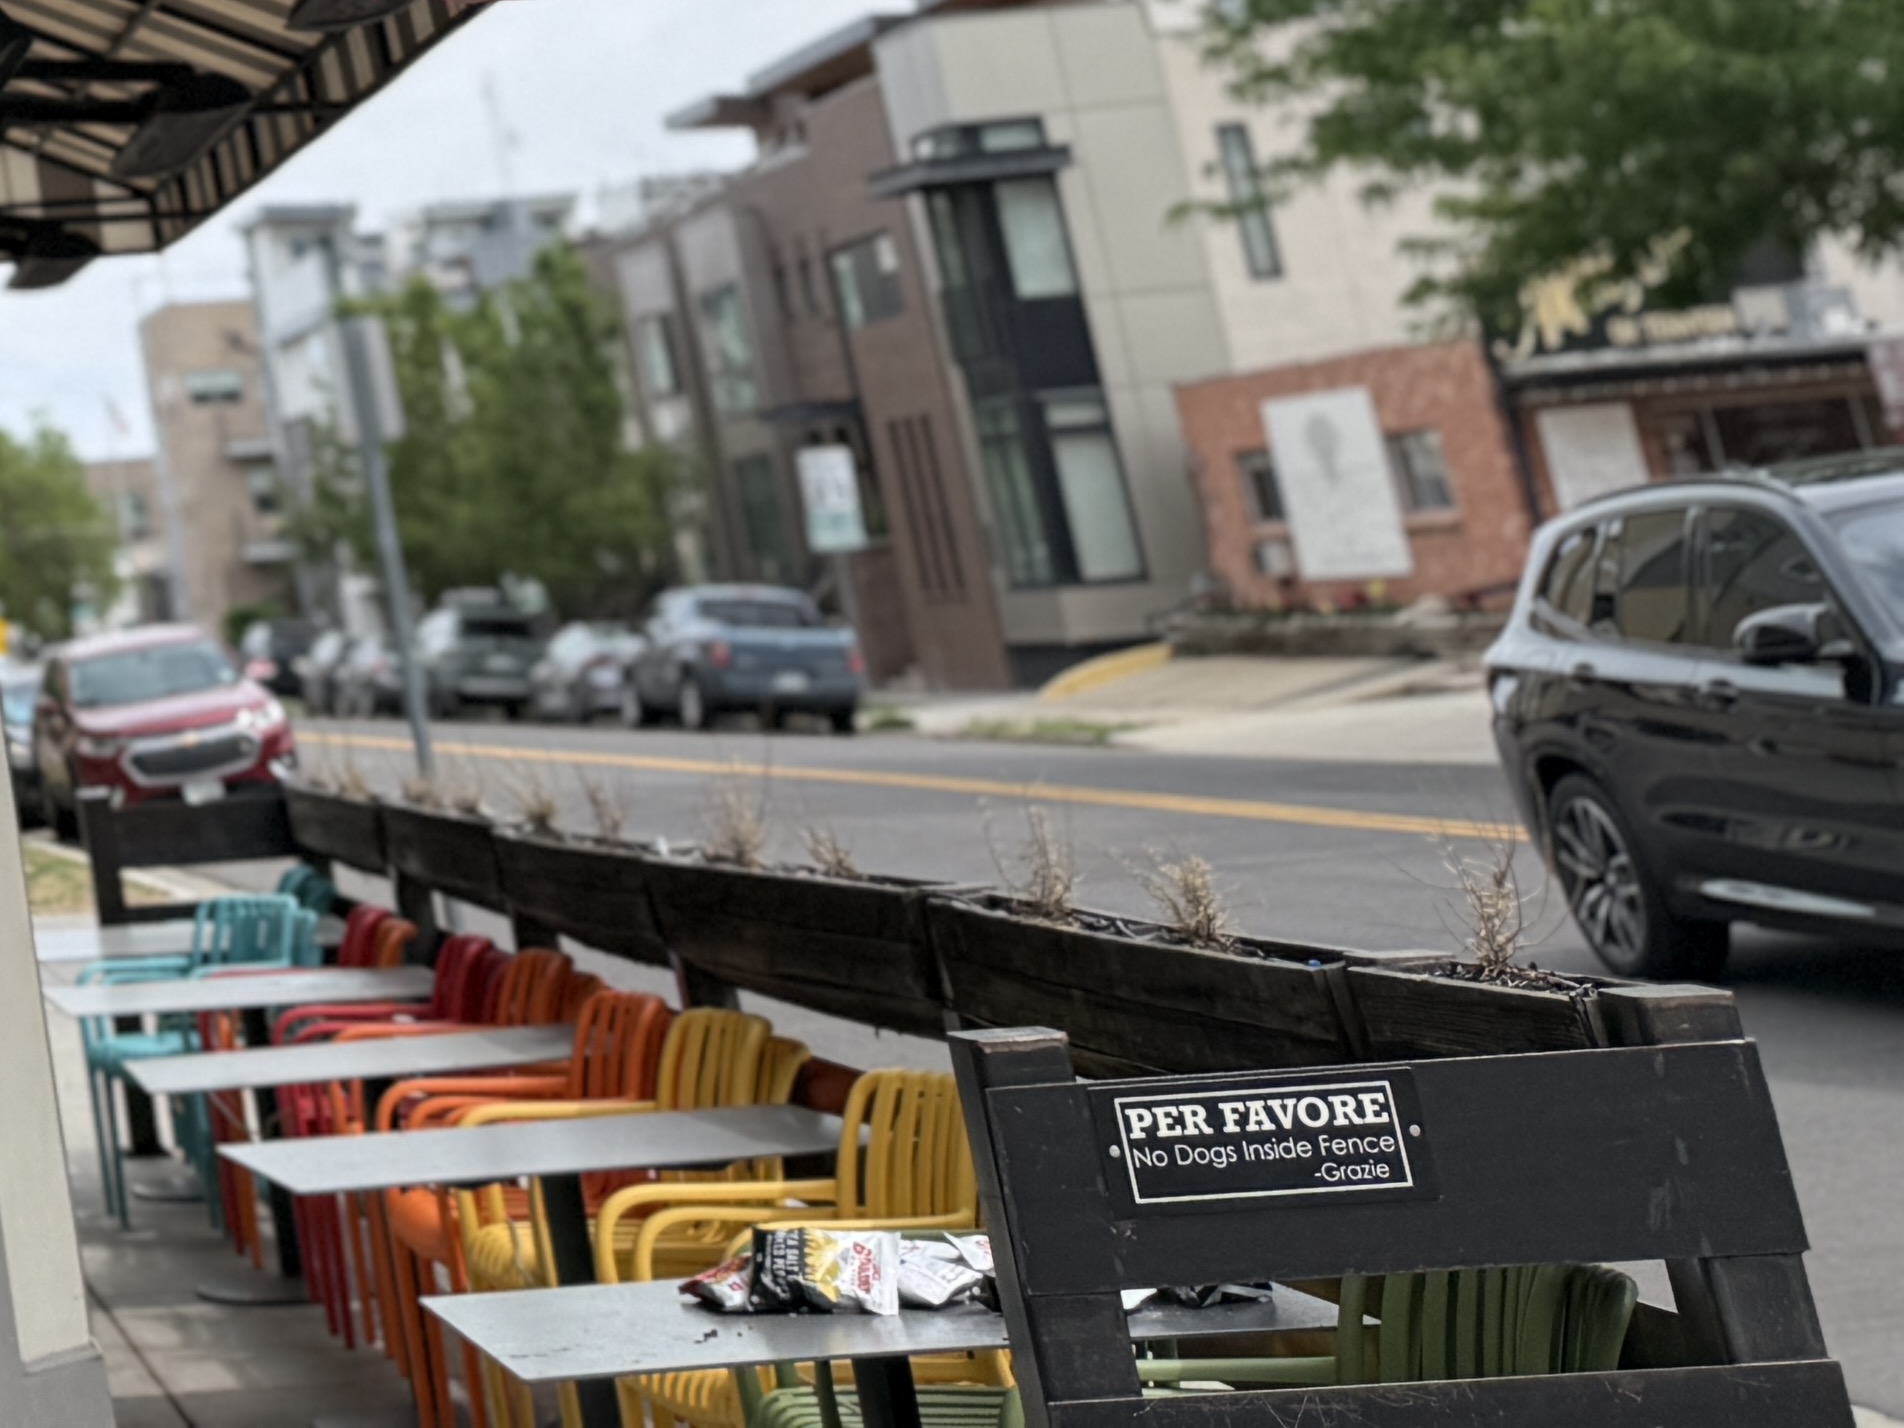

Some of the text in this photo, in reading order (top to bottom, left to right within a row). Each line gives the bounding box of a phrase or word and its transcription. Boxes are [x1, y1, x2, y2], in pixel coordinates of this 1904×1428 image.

[1124, 1092, 1390, 1140] PER FAVORE
[1133, 1133, 1396, 1169] No Dogs Inside Fence
[1314, 1160, 1390, 1183] -Grazie
